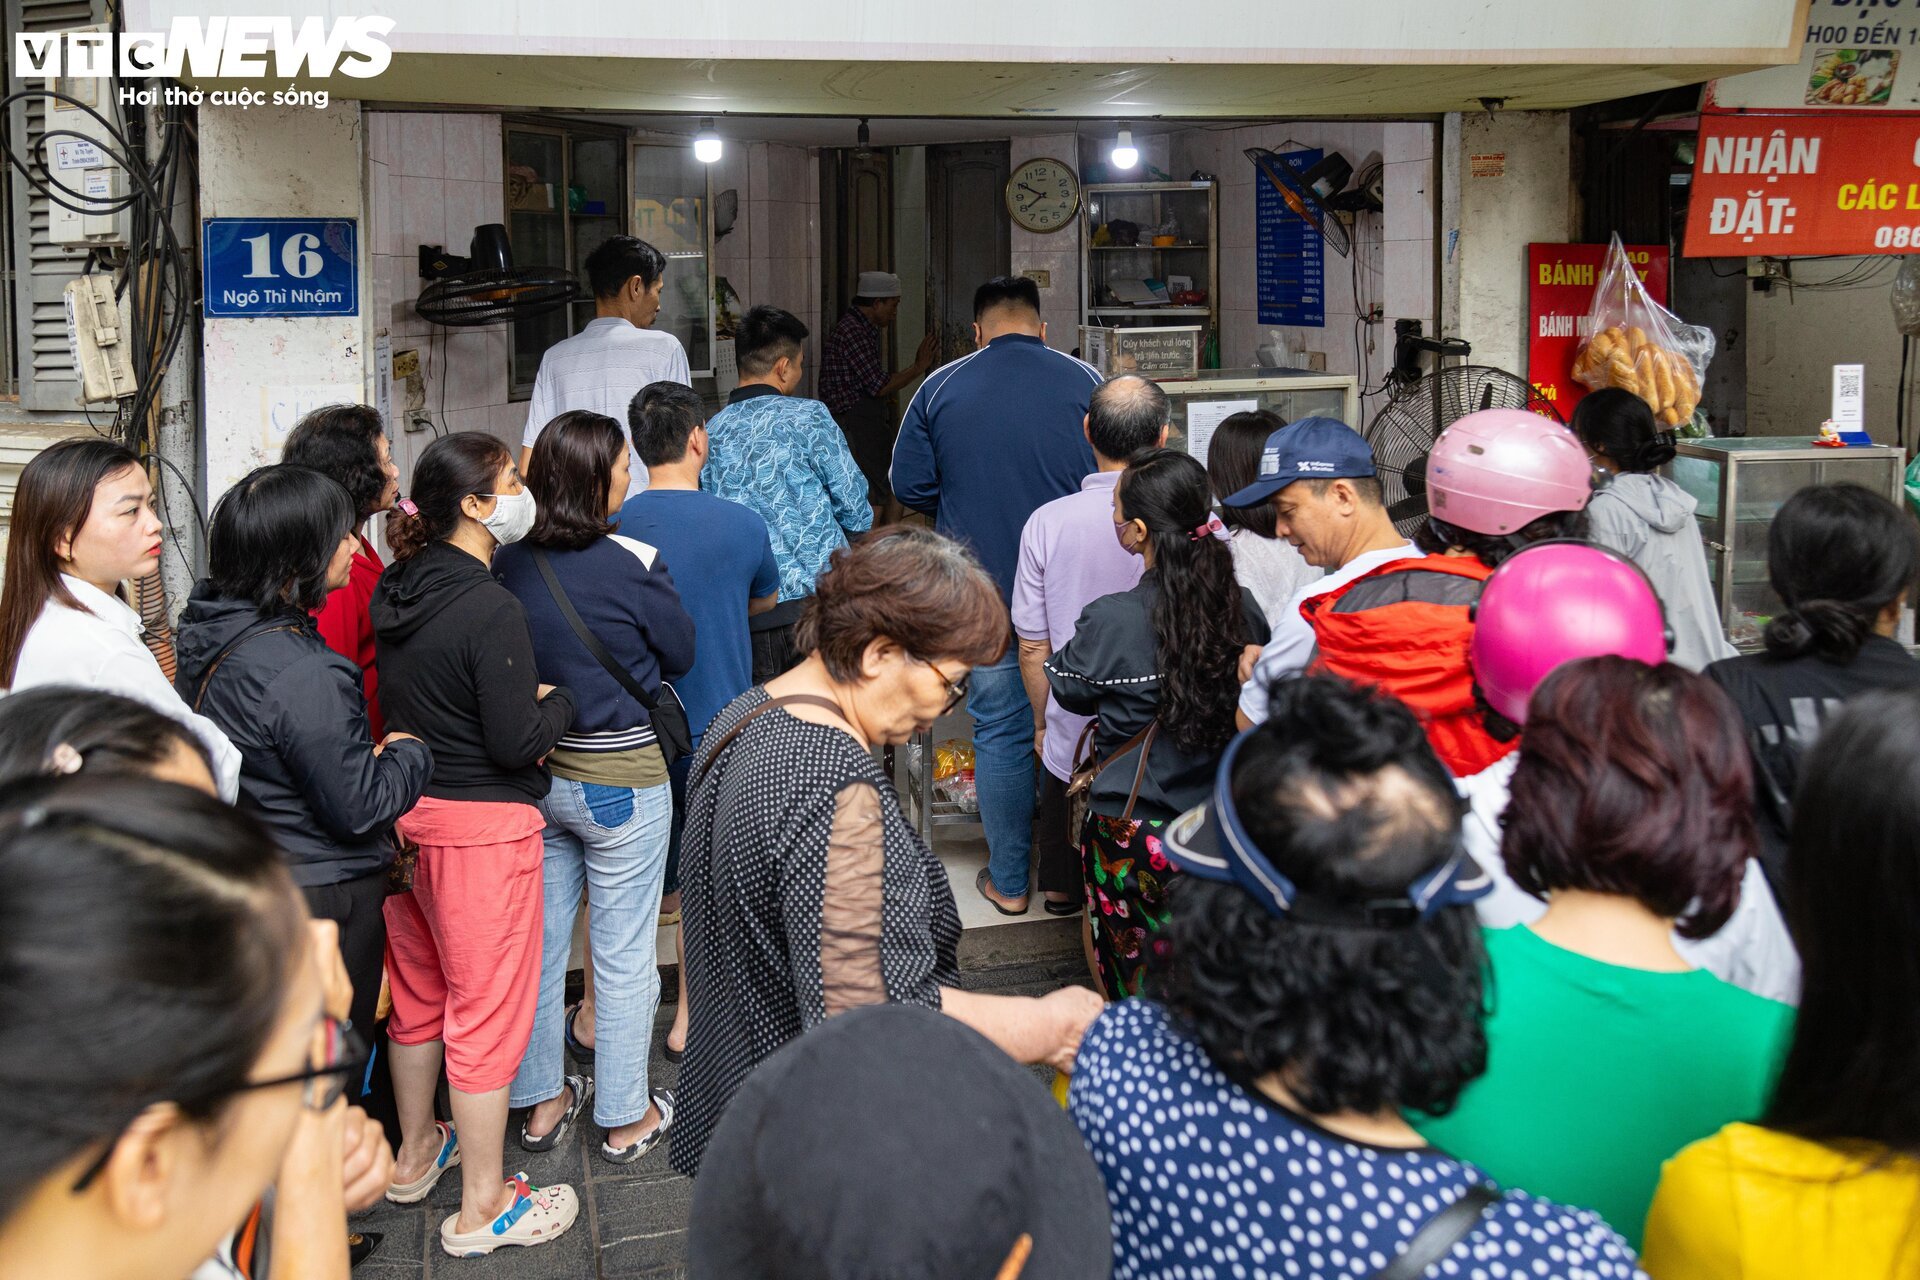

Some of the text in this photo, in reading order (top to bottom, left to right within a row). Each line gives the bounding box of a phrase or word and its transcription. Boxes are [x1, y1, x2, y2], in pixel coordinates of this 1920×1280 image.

[1853, 19, 1901, 45] ĐẾN
[1702, 129, 1821, 183] NHẬN
[1837, 178, 1899, 211] CÁC
[1709, 189, 1797, 243] ĐẶT:
[241, 232, 324, 279] 16
[1538, 258, 1594, 286] BÁNH
[223, 288, 342, 308] Ngô Thì Nhậm
[1538, 310, 1573, 337] BÁNH
[1532, 382, 1558, 401] Trà
